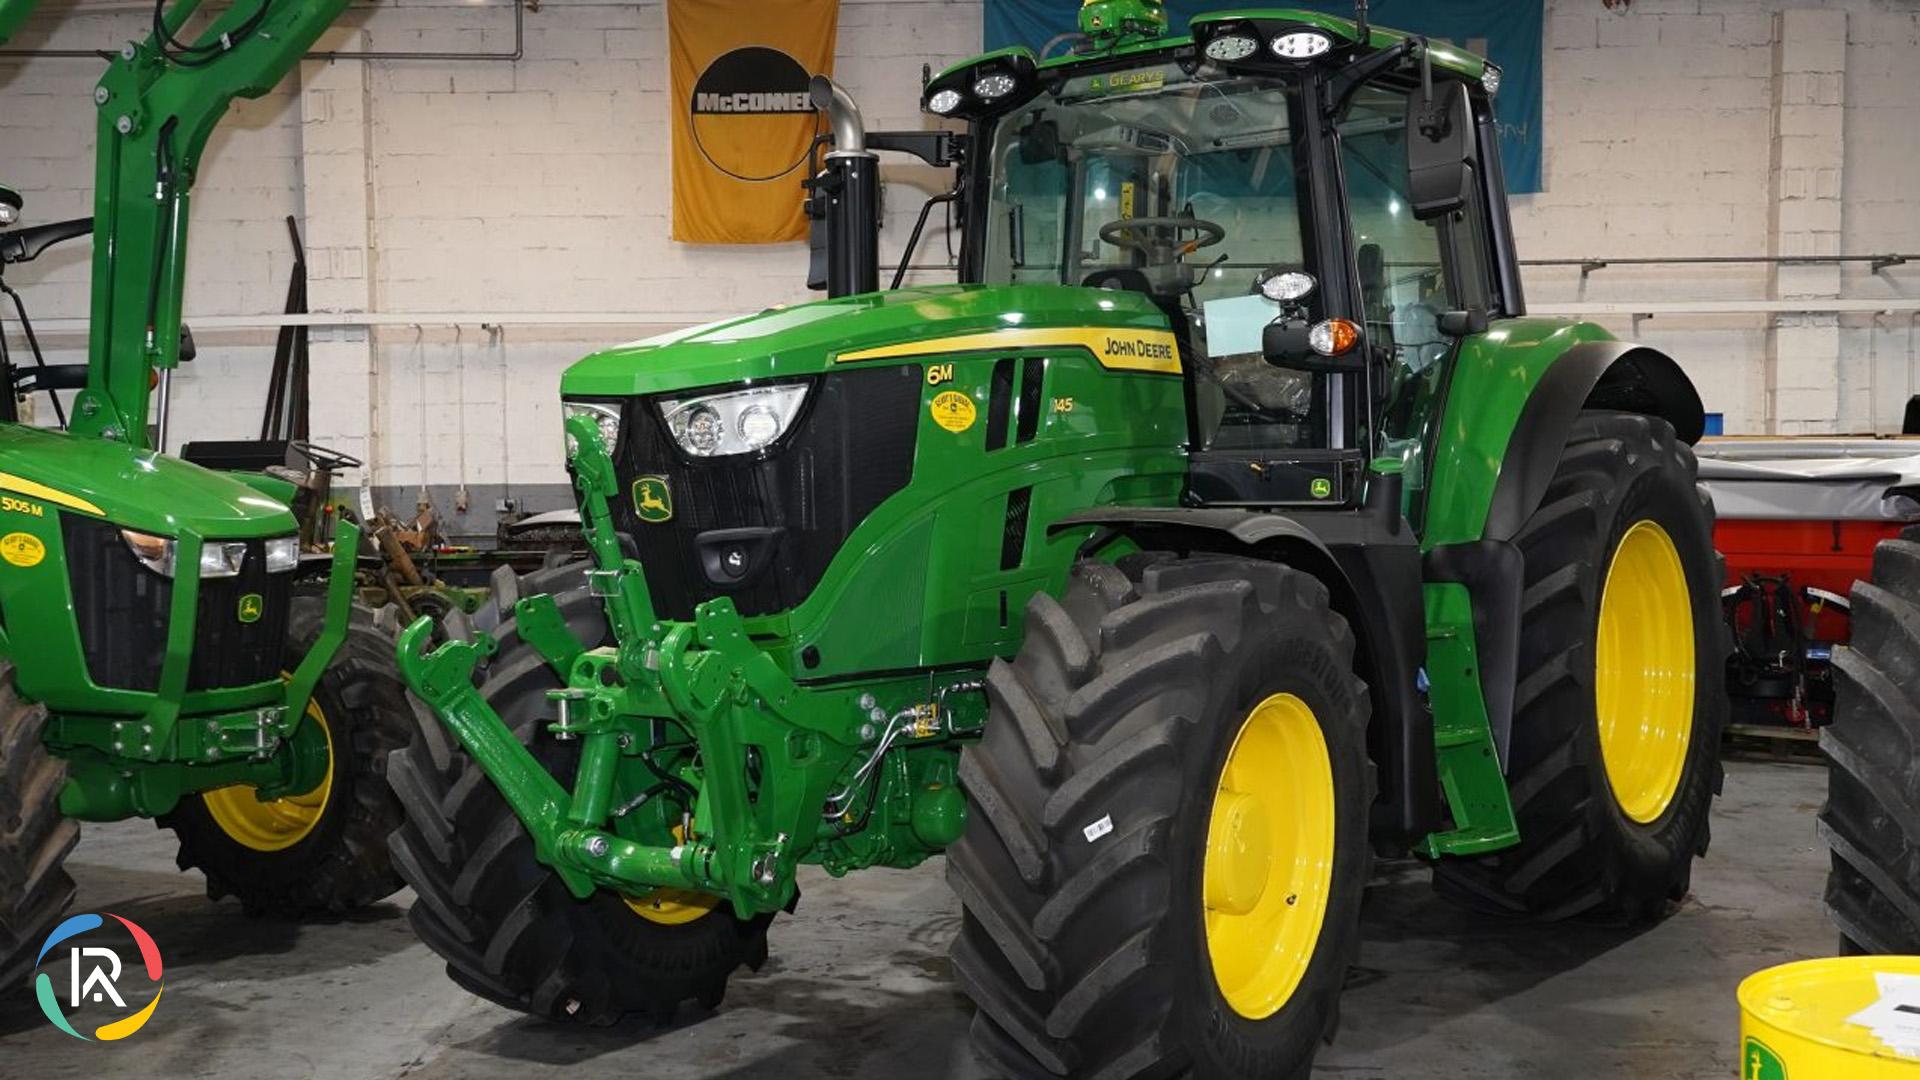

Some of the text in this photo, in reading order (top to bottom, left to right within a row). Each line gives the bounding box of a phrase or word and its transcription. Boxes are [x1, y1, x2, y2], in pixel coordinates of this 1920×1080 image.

[1105, 337, 1172, 360] JOHN DEERE
[927, 363, 953, 385] 6M
[1053, 397, 1073, 413] 145
